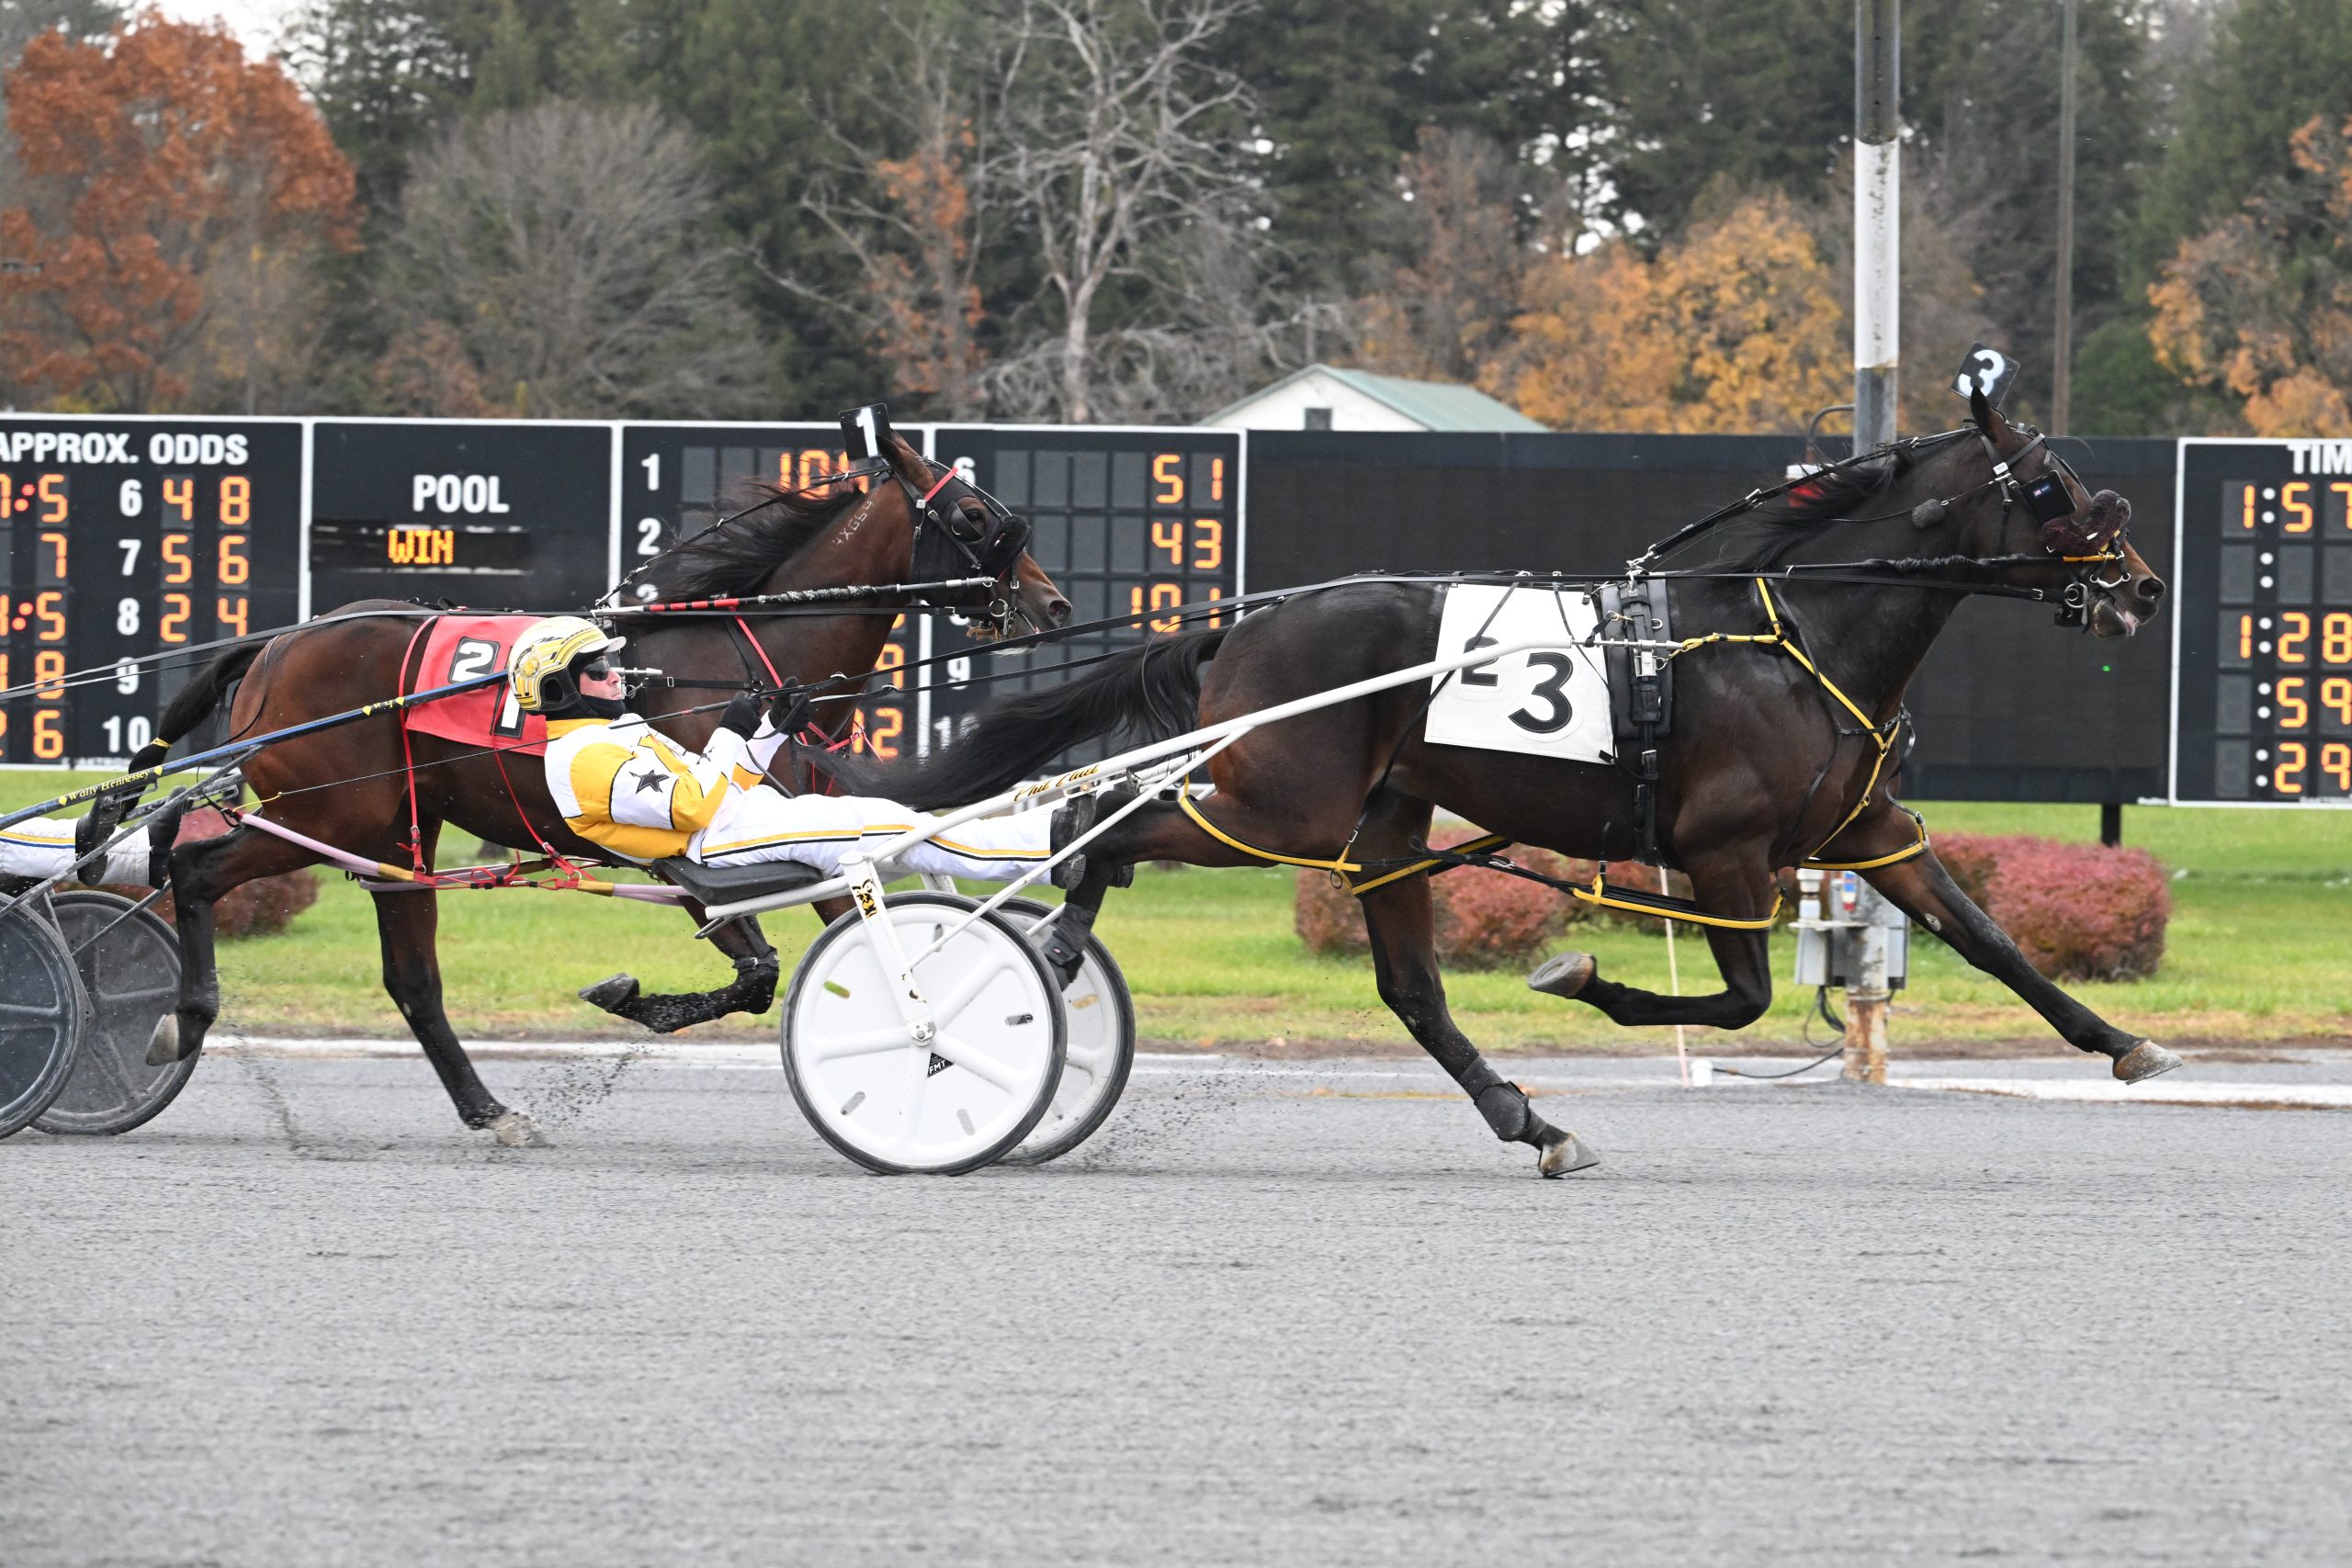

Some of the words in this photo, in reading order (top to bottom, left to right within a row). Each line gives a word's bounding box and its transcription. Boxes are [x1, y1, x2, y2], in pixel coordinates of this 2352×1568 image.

[1958, 349, 2005, 398] 3
[149, 433, 248, 465] ODDS
[855, 407, 878, 457] 1
[641, 453, 660, 491] 1
[119, 479, 142, 516] 6
[413, 474, 510, 513] POOL
[389, 529, 454, 564] WIN
[638, 517, 661, 556] 2
[119, 539, 141, 576] 7
[117, 597, 140, 636] 8
[116, 657, 140, 694] 9
[451, 641, 494, 682] 2
[1508, 653, 1573, 733] 3
[0, 709, 63, 759] 6
[103, 716, 151, 753] 10
[929, 1059, 946, 1075] FMT
